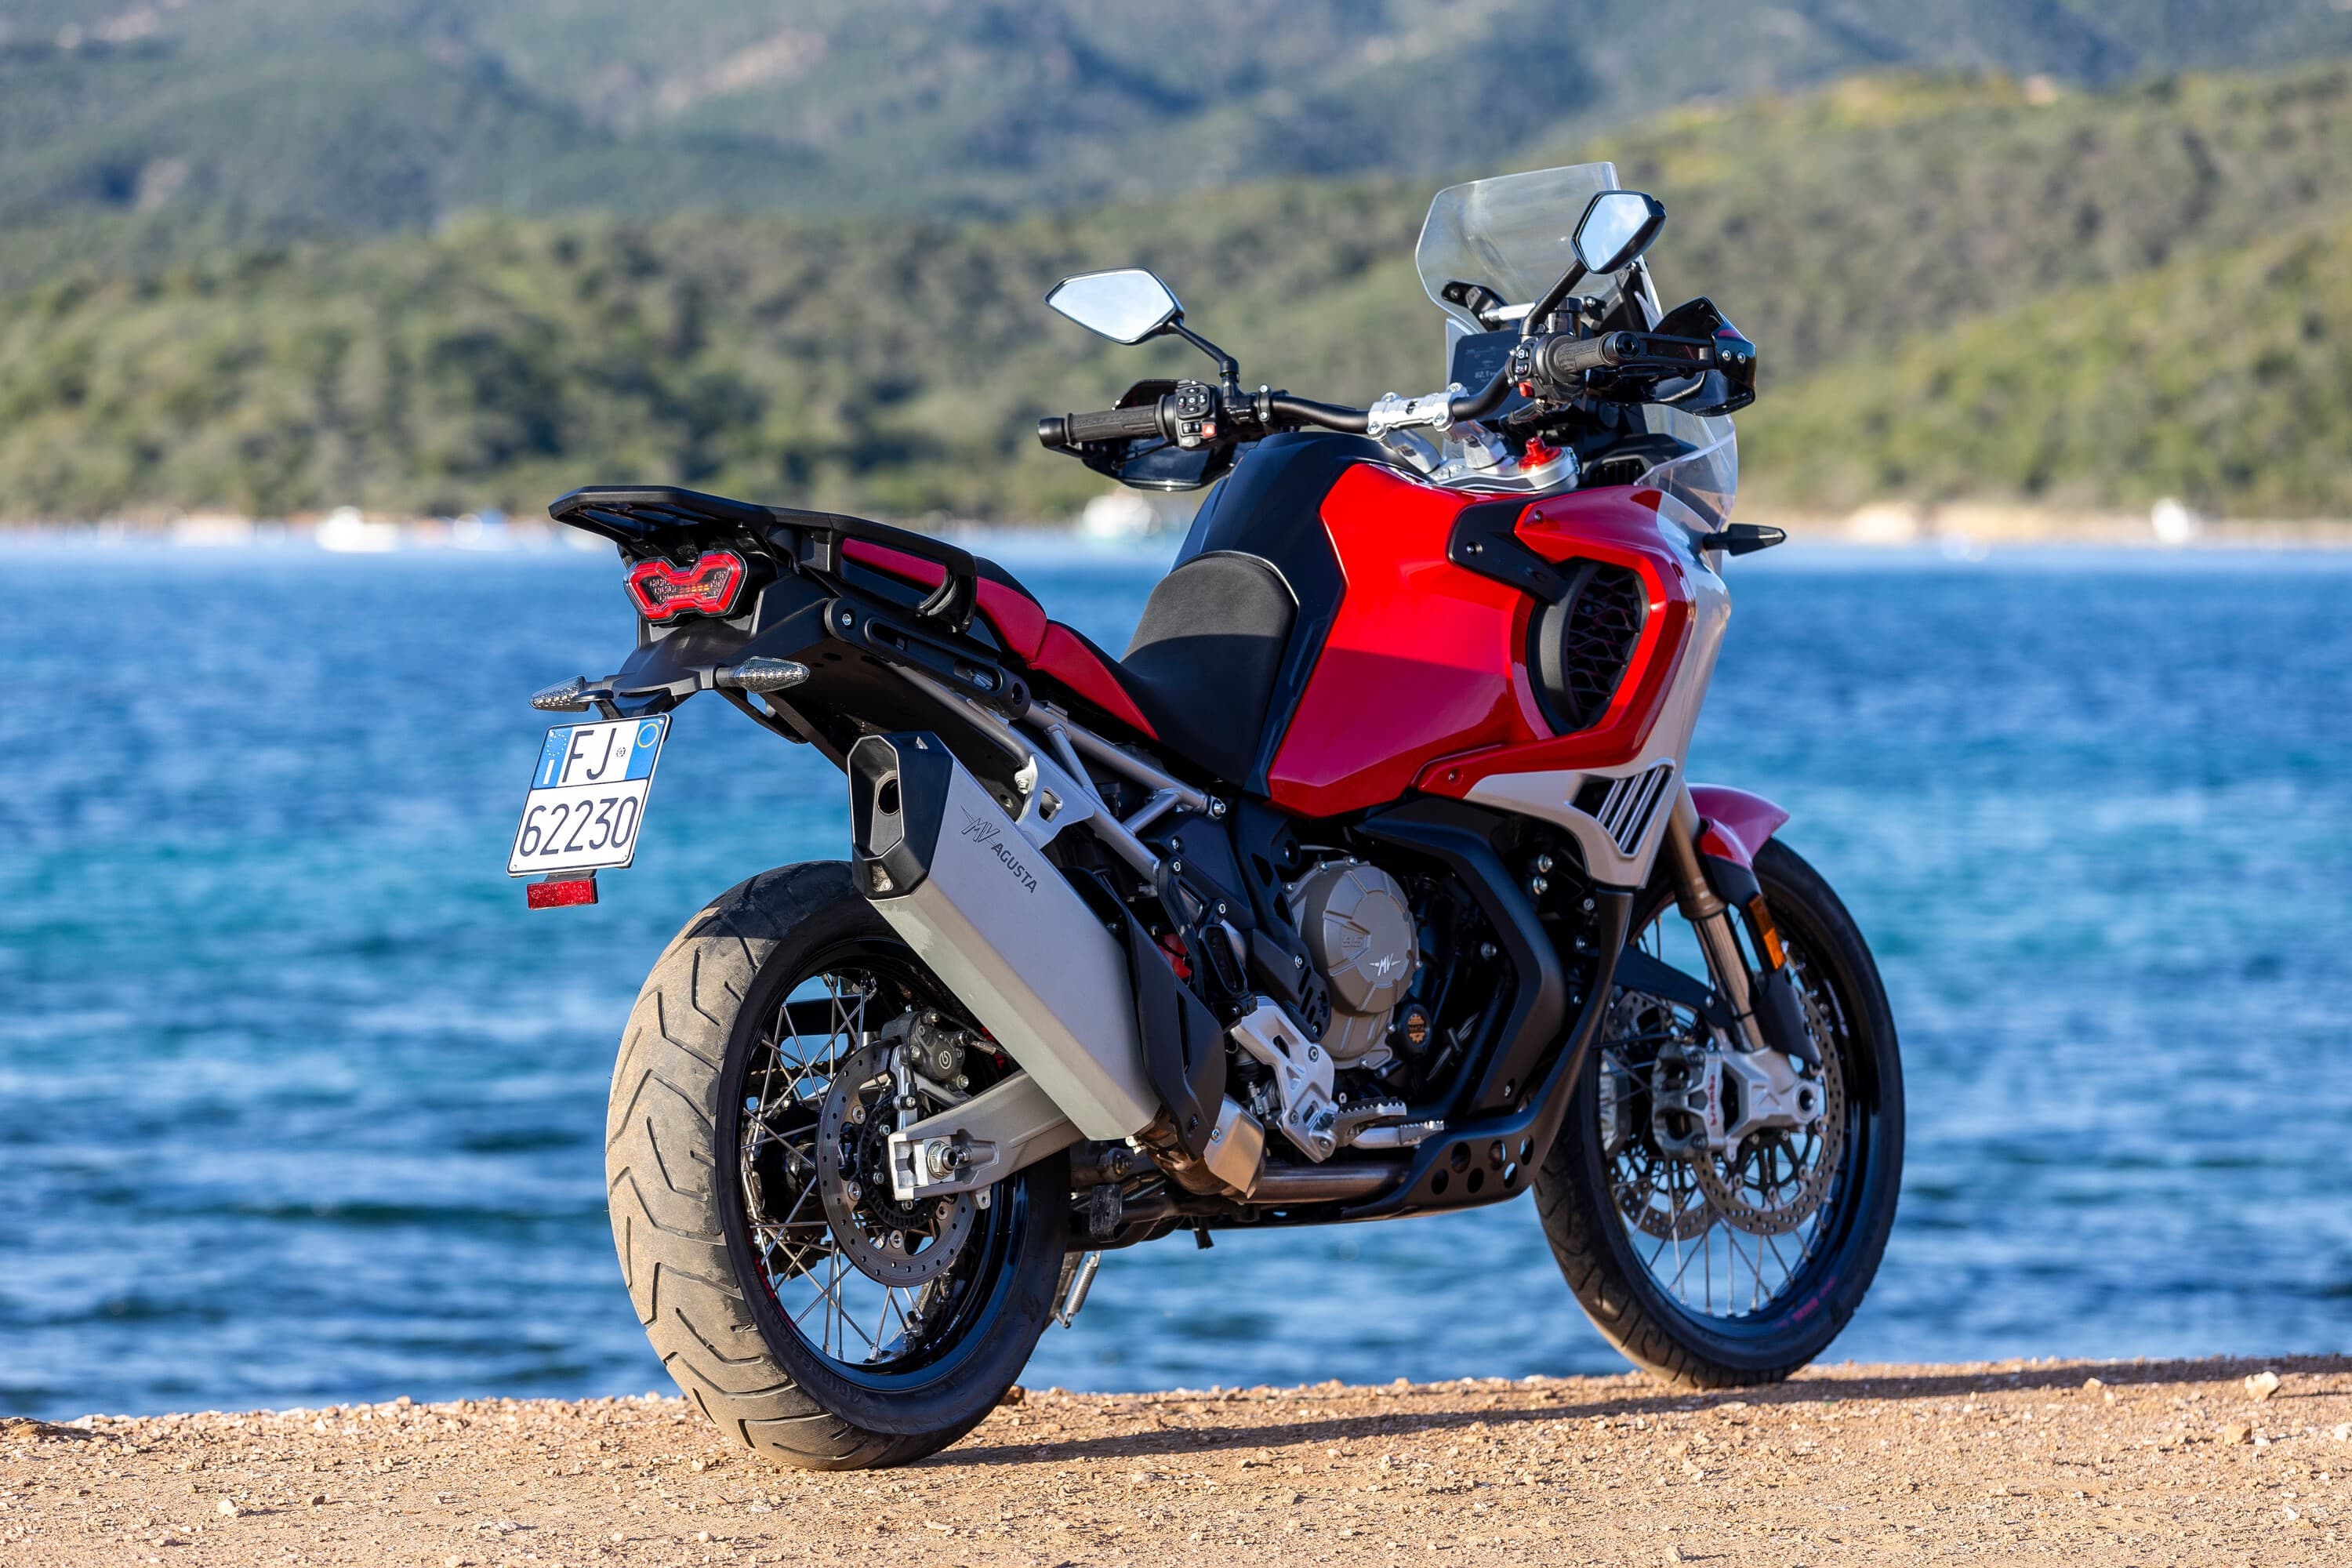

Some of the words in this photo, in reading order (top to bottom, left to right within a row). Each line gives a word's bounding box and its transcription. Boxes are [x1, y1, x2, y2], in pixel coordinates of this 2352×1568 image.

[562, 728, 617, 782] FJ
[519, 796, 638, 857] 62230
[960, 816, 1000, 843] MV
[991, 843, 1037, 893] AGUSTA
[1375, 953, 1396, 976] MV
